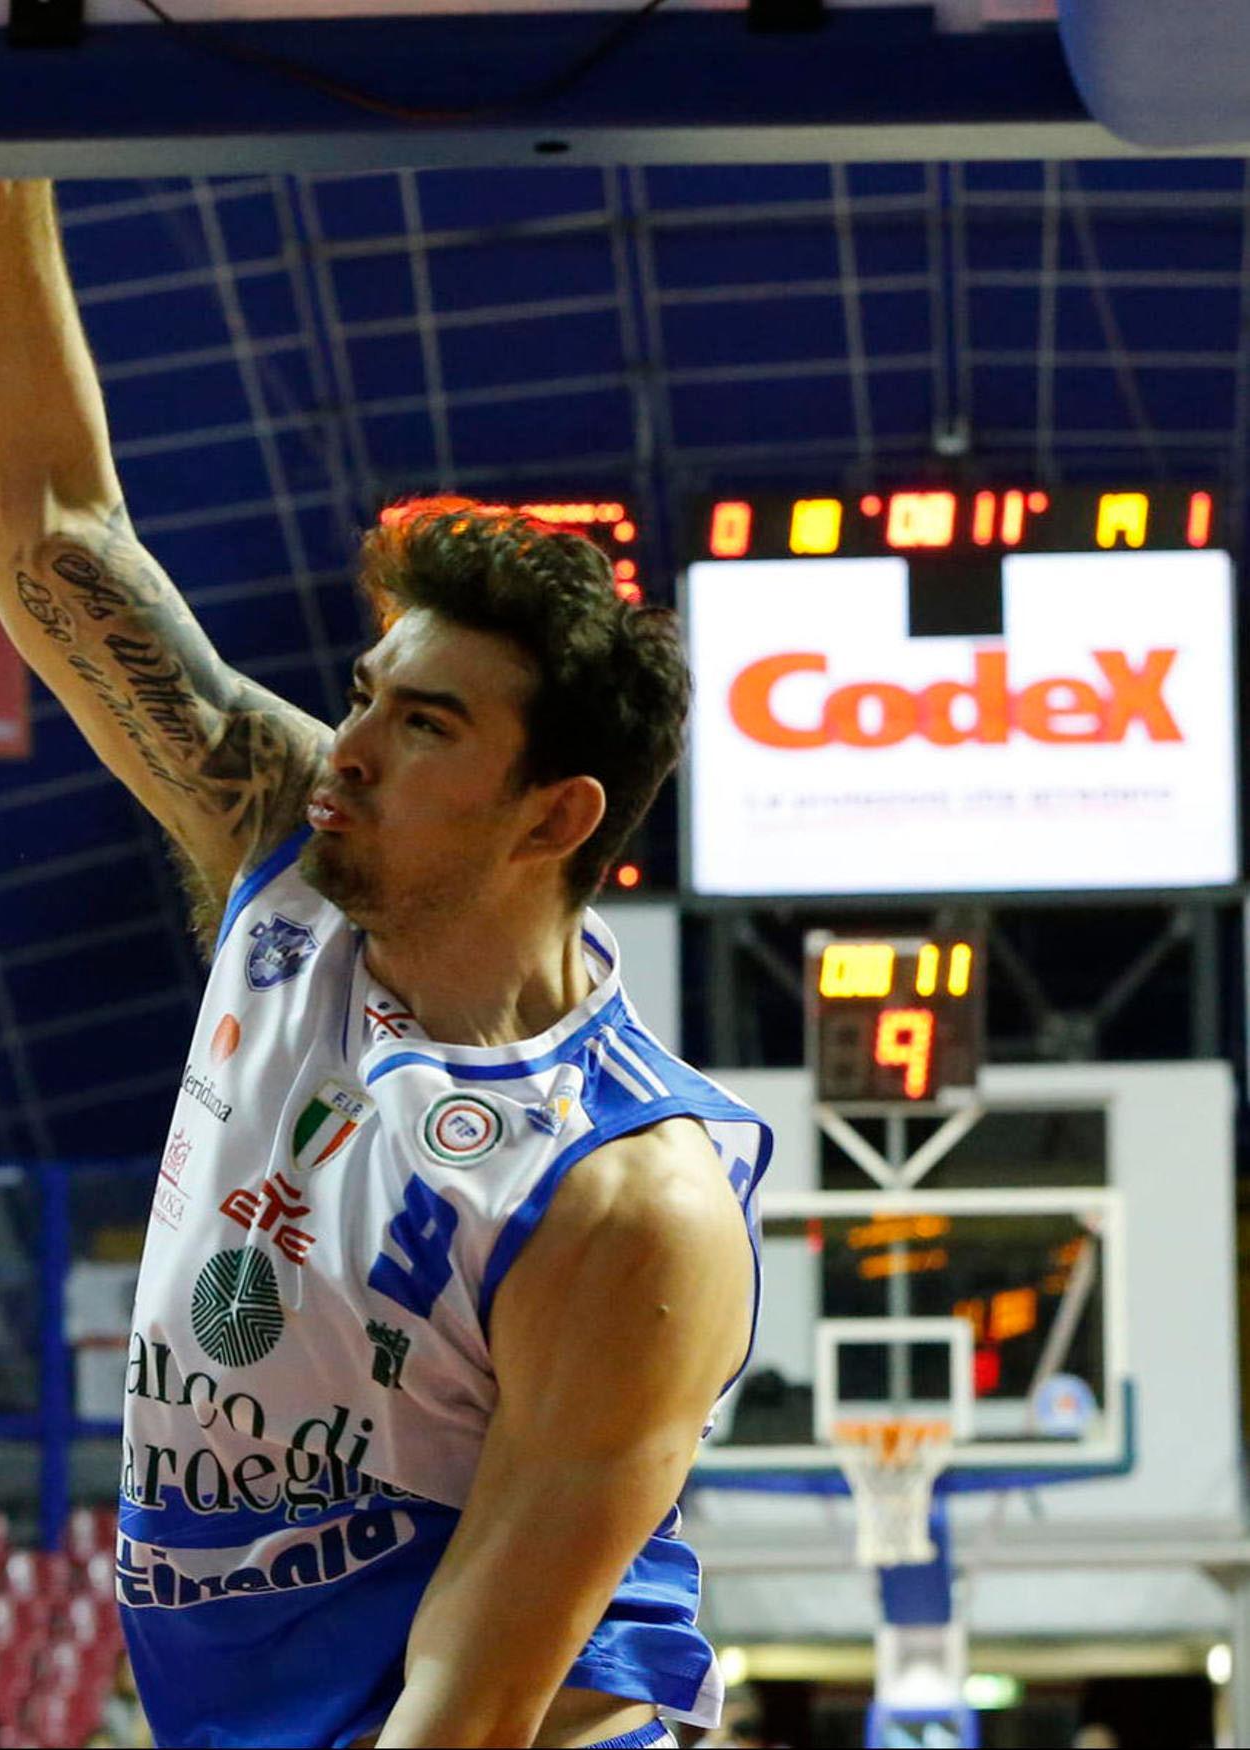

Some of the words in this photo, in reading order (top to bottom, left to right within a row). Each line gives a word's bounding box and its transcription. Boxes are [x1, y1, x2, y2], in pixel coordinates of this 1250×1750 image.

[875, 1008, 935, 1099] 9
[447, 1114, 479, 1139] FIP
[292, 1405, 376, 1468] di
